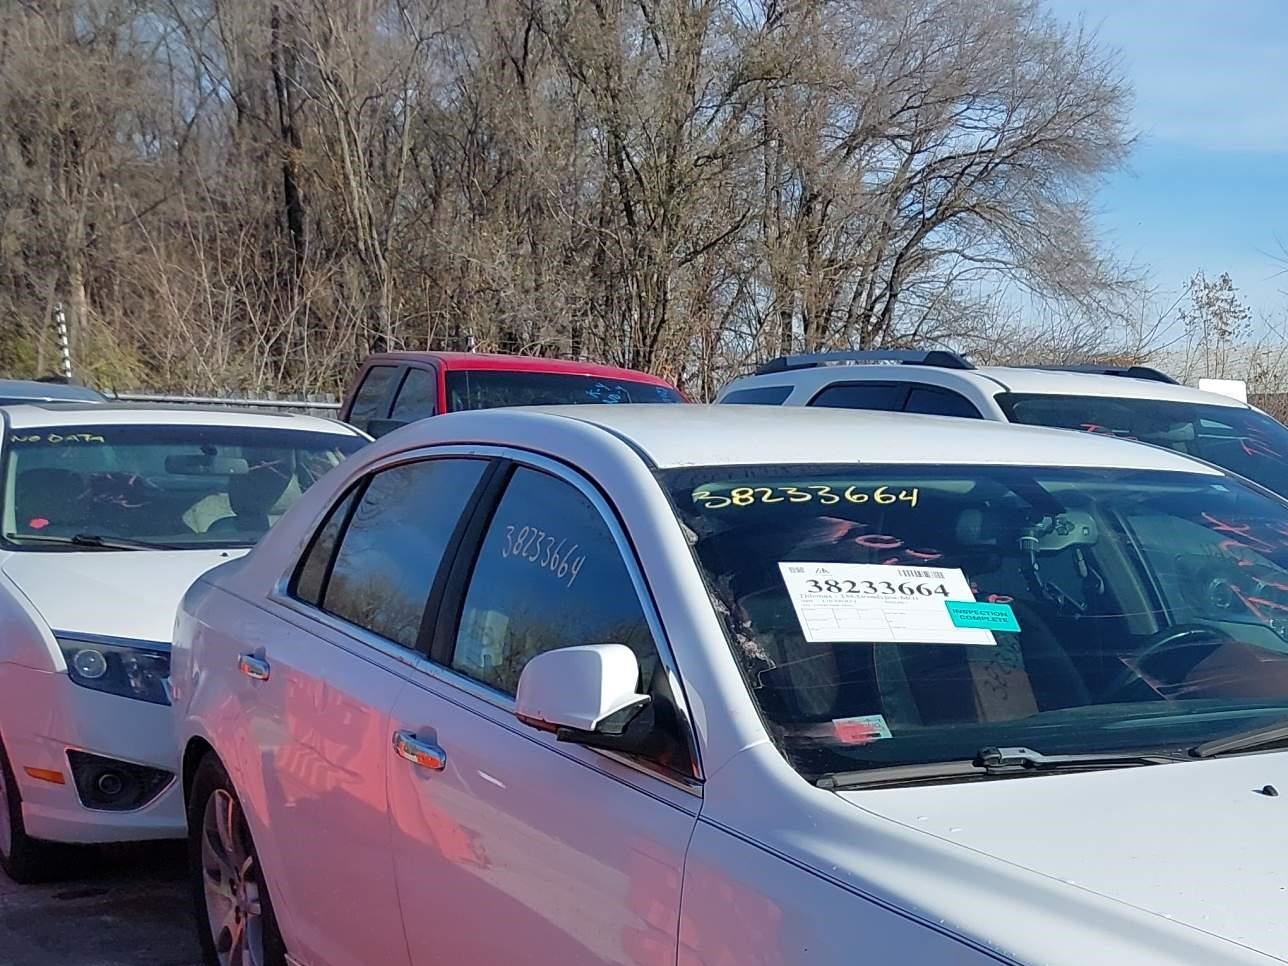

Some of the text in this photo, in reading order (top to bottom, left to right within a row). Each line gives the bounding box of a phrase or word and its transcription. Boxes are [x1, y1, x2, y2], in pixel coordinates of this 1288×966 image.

[691, 485, 919, 508] 38233664
[502, 525, 587, 588] 38233664
[805, 578, 951, 597] 38233664
[952, 608, 1009, 618] INSPECTION
[959, 614, 1009, 623] COMPLETE
